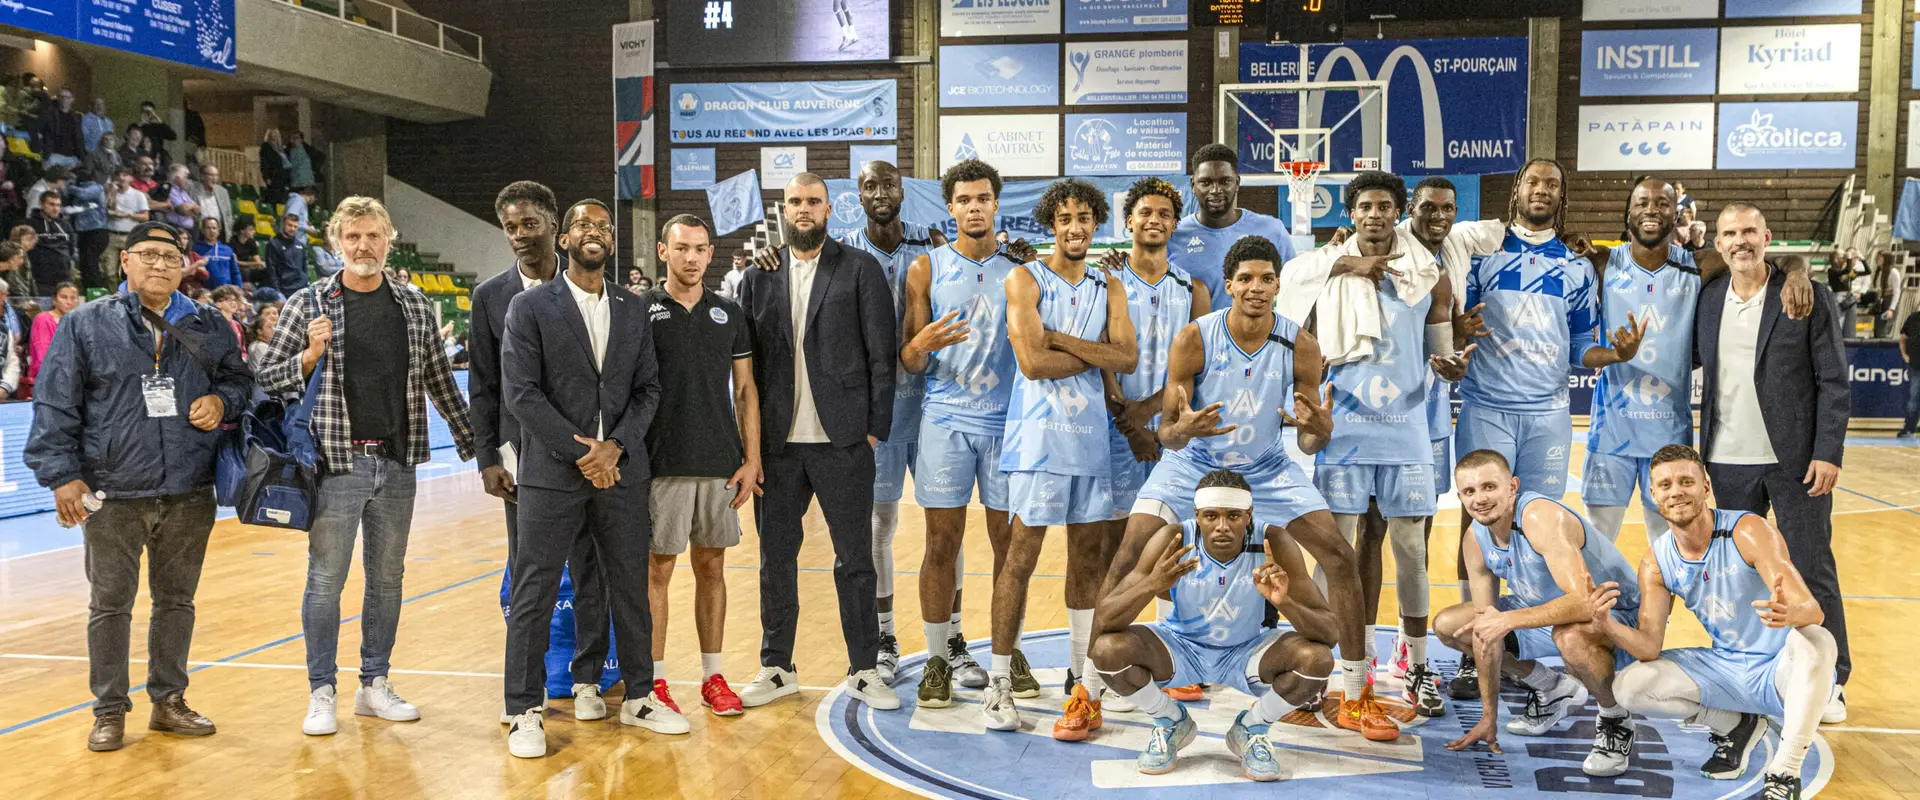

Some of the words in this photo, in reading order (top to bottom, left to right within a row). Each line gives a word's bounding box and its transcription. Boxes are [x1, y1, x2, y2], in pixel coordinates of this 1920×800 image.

[704, 1, 733, 29] #4
[620, 40, 646, 50] VICHY
[1094, 49, 1135, 59] GRANGE
[1139, 48, 1184, 59] plomberie
[1597, 44, 1700, 70] INSTILL
[1748, 41, 1832, 69] Kyriad
[1250, 61, 1316, 76] BELLERIE
[1434, 57, 1517, 75] ST-POURÇAIN
[948, 86, 966, 95] JCE
[967, 84, 1054, 95] BIOTECHNOLOGY
[704, 101, 754, 111] DRAGON
[759, 100, 790, 111] CLUB
[794, 99, 862, 110] AUVERGNE
[1134, 118, 1174, 126] Location
[671, 130, 702, 139] TOUS
[706, 129, 721, 138] AU
[724, 129, 770, 138] REBOND
[774, 128, 804, 138] AVEC
[807, 128, 829, 137] LES
[833, 127, 889, 137] DRAGONS
[987, 131, 1045, 141] CABINET
[1126, 127, 1137, 135] de
[1140, 126, 1181, 134] vaisselle
[987, 143, 1045, 154] MAITRIAS
[1135, 141, 1172, 149] Matériel
[1448, 140, 1513, 158] GANNAT
[1125, 150, 1136, 158] de
[1138, 149, 1182, 158] réception
[1639, 338, 1657, 365] 6
[943, 396, 1004, 412] Carrefour
[1345, 412, 1408, 424] Carrefour
[1619, 408, 1675, 419] Carrefour
[1038, 418, 1094, 434] Carrefour
